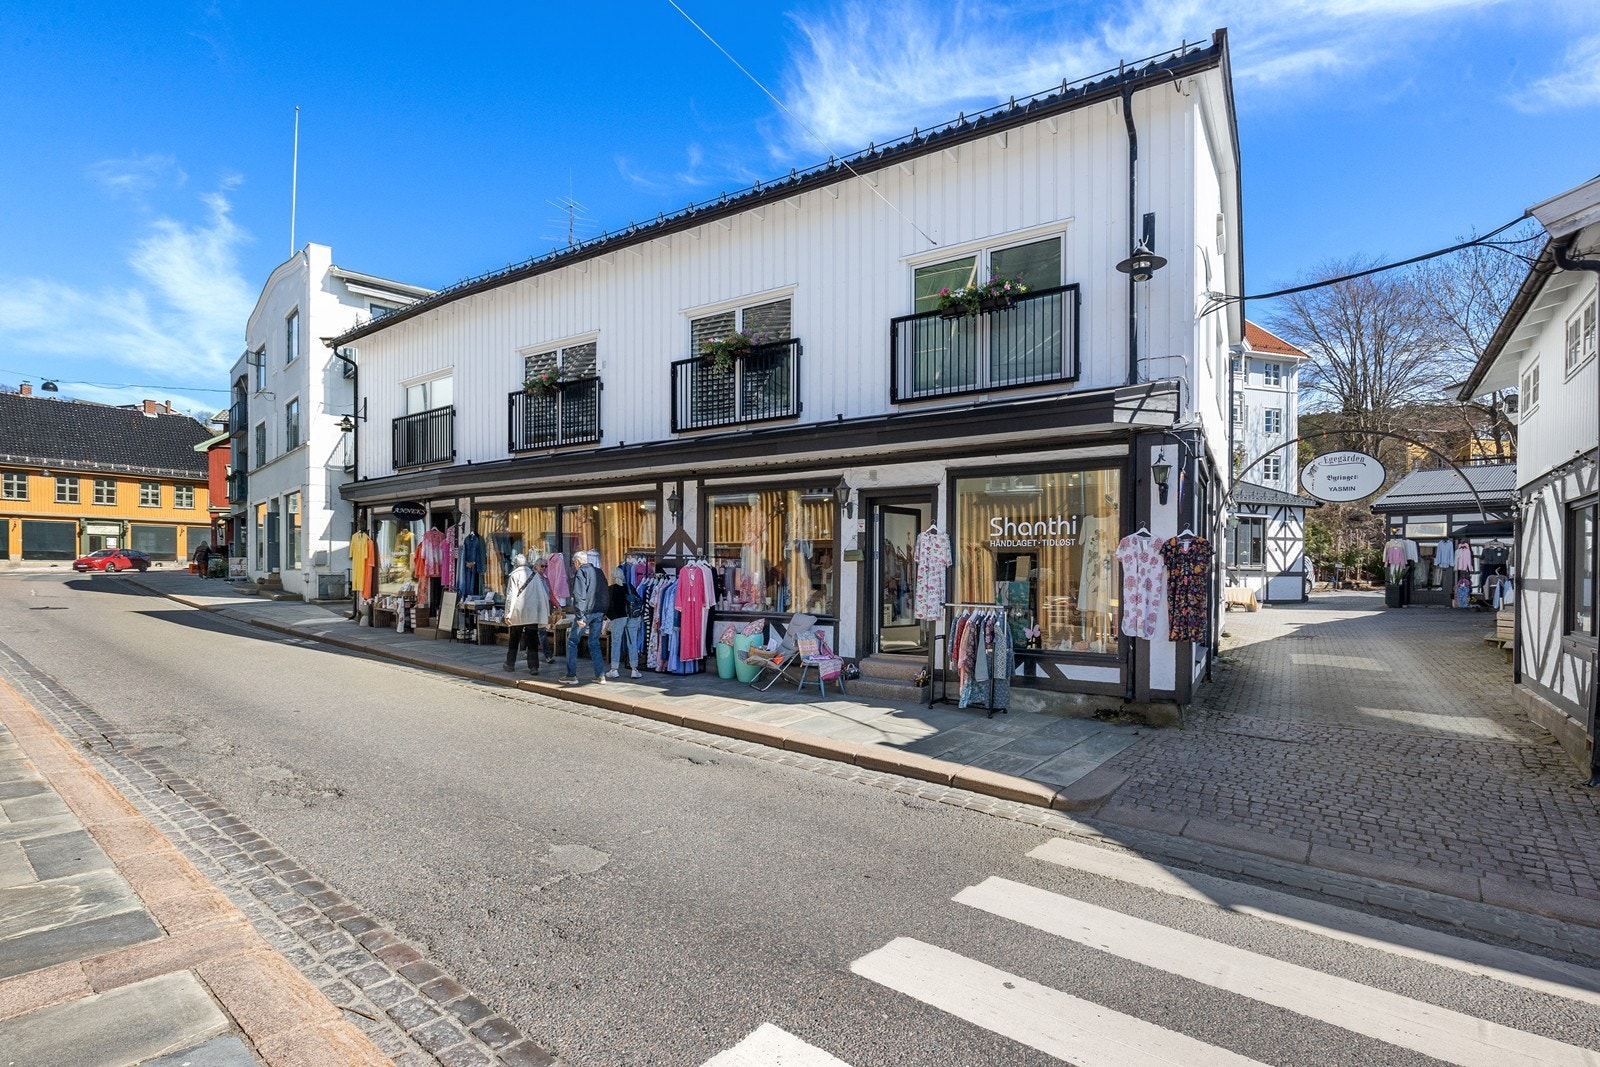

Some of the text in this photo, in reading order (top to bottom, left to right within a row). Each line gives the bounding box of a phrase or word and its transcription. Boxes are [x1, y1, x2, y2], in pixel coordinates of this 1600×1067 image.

[990, 515, 1077, 537] Shanthi
[990, 538, 1076, 547] HÅNDLAGET TIDLØST
